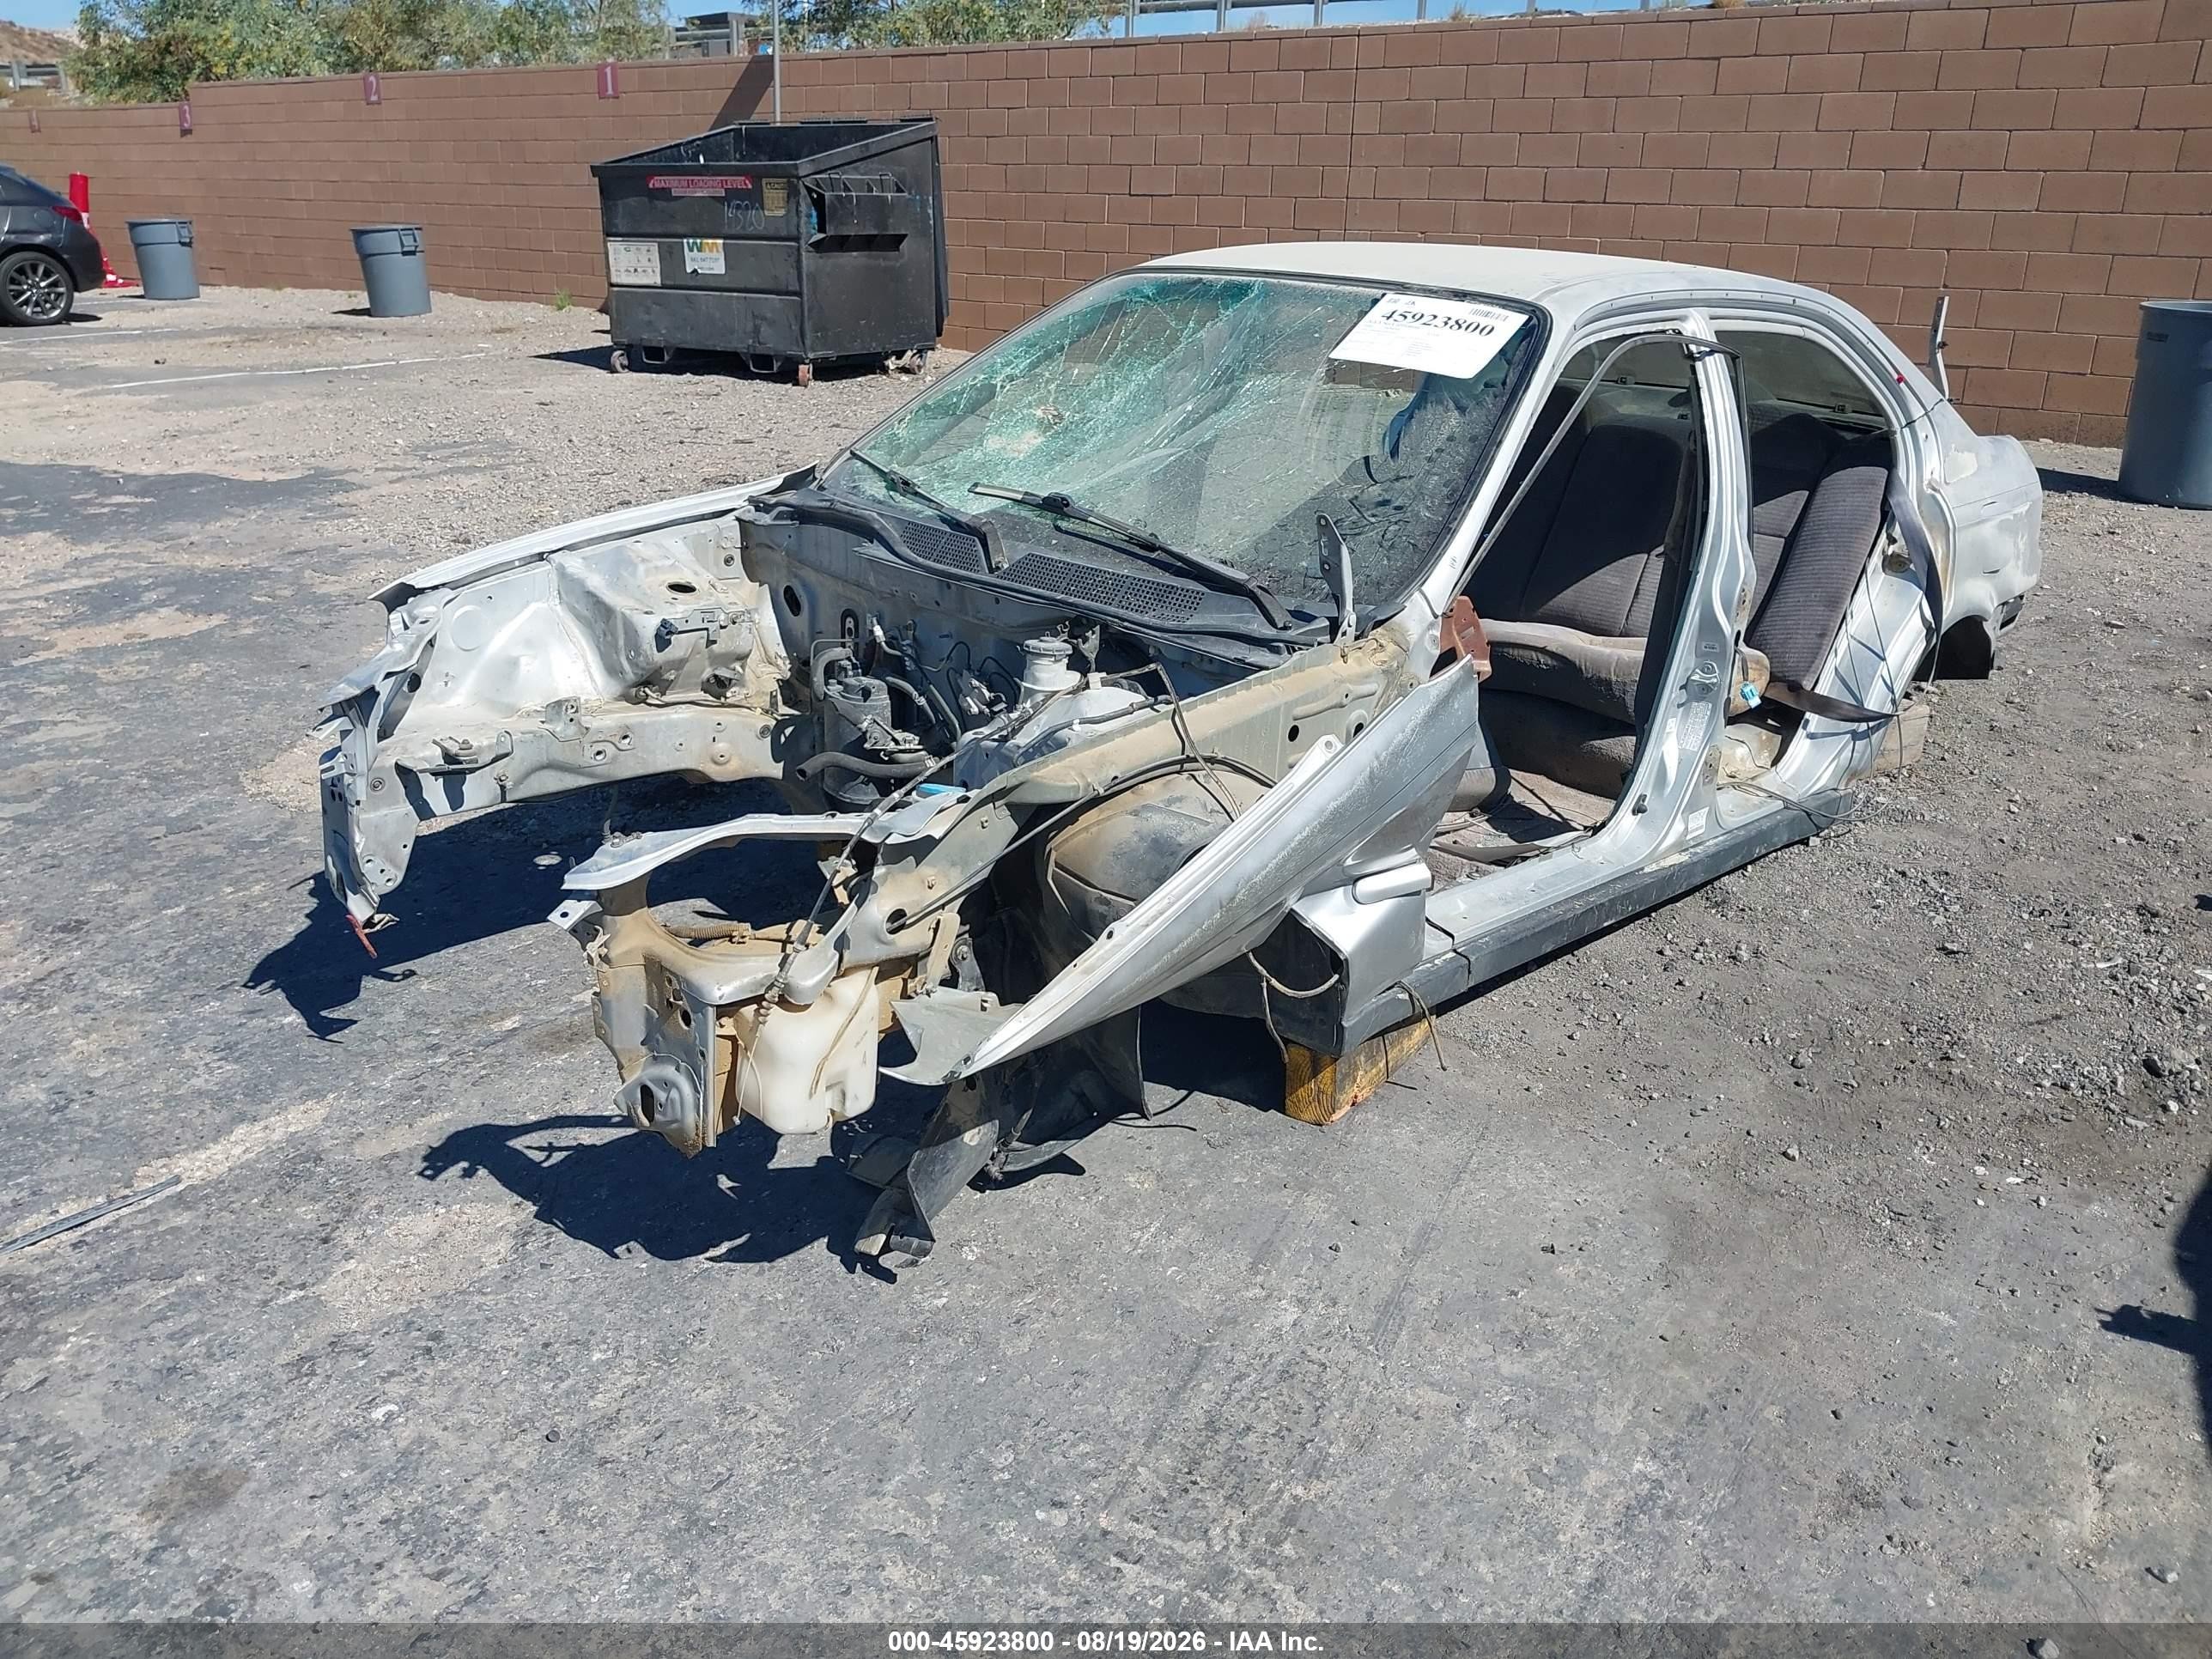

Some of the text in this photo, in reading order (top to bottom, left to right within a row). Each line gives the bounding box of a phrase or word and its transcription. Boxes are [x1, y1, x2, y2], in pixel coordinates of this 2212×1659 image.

[368, 75, 379, 101] 2
[605, 66, 614, 95] 1
[182, 105, 191, 128] 3
[653, 178, 746, 188] MAXIMUM LOADING LEVEL
[686, 240, 720, 252] WM
[1381, 309, 1495, 337] 45923800
